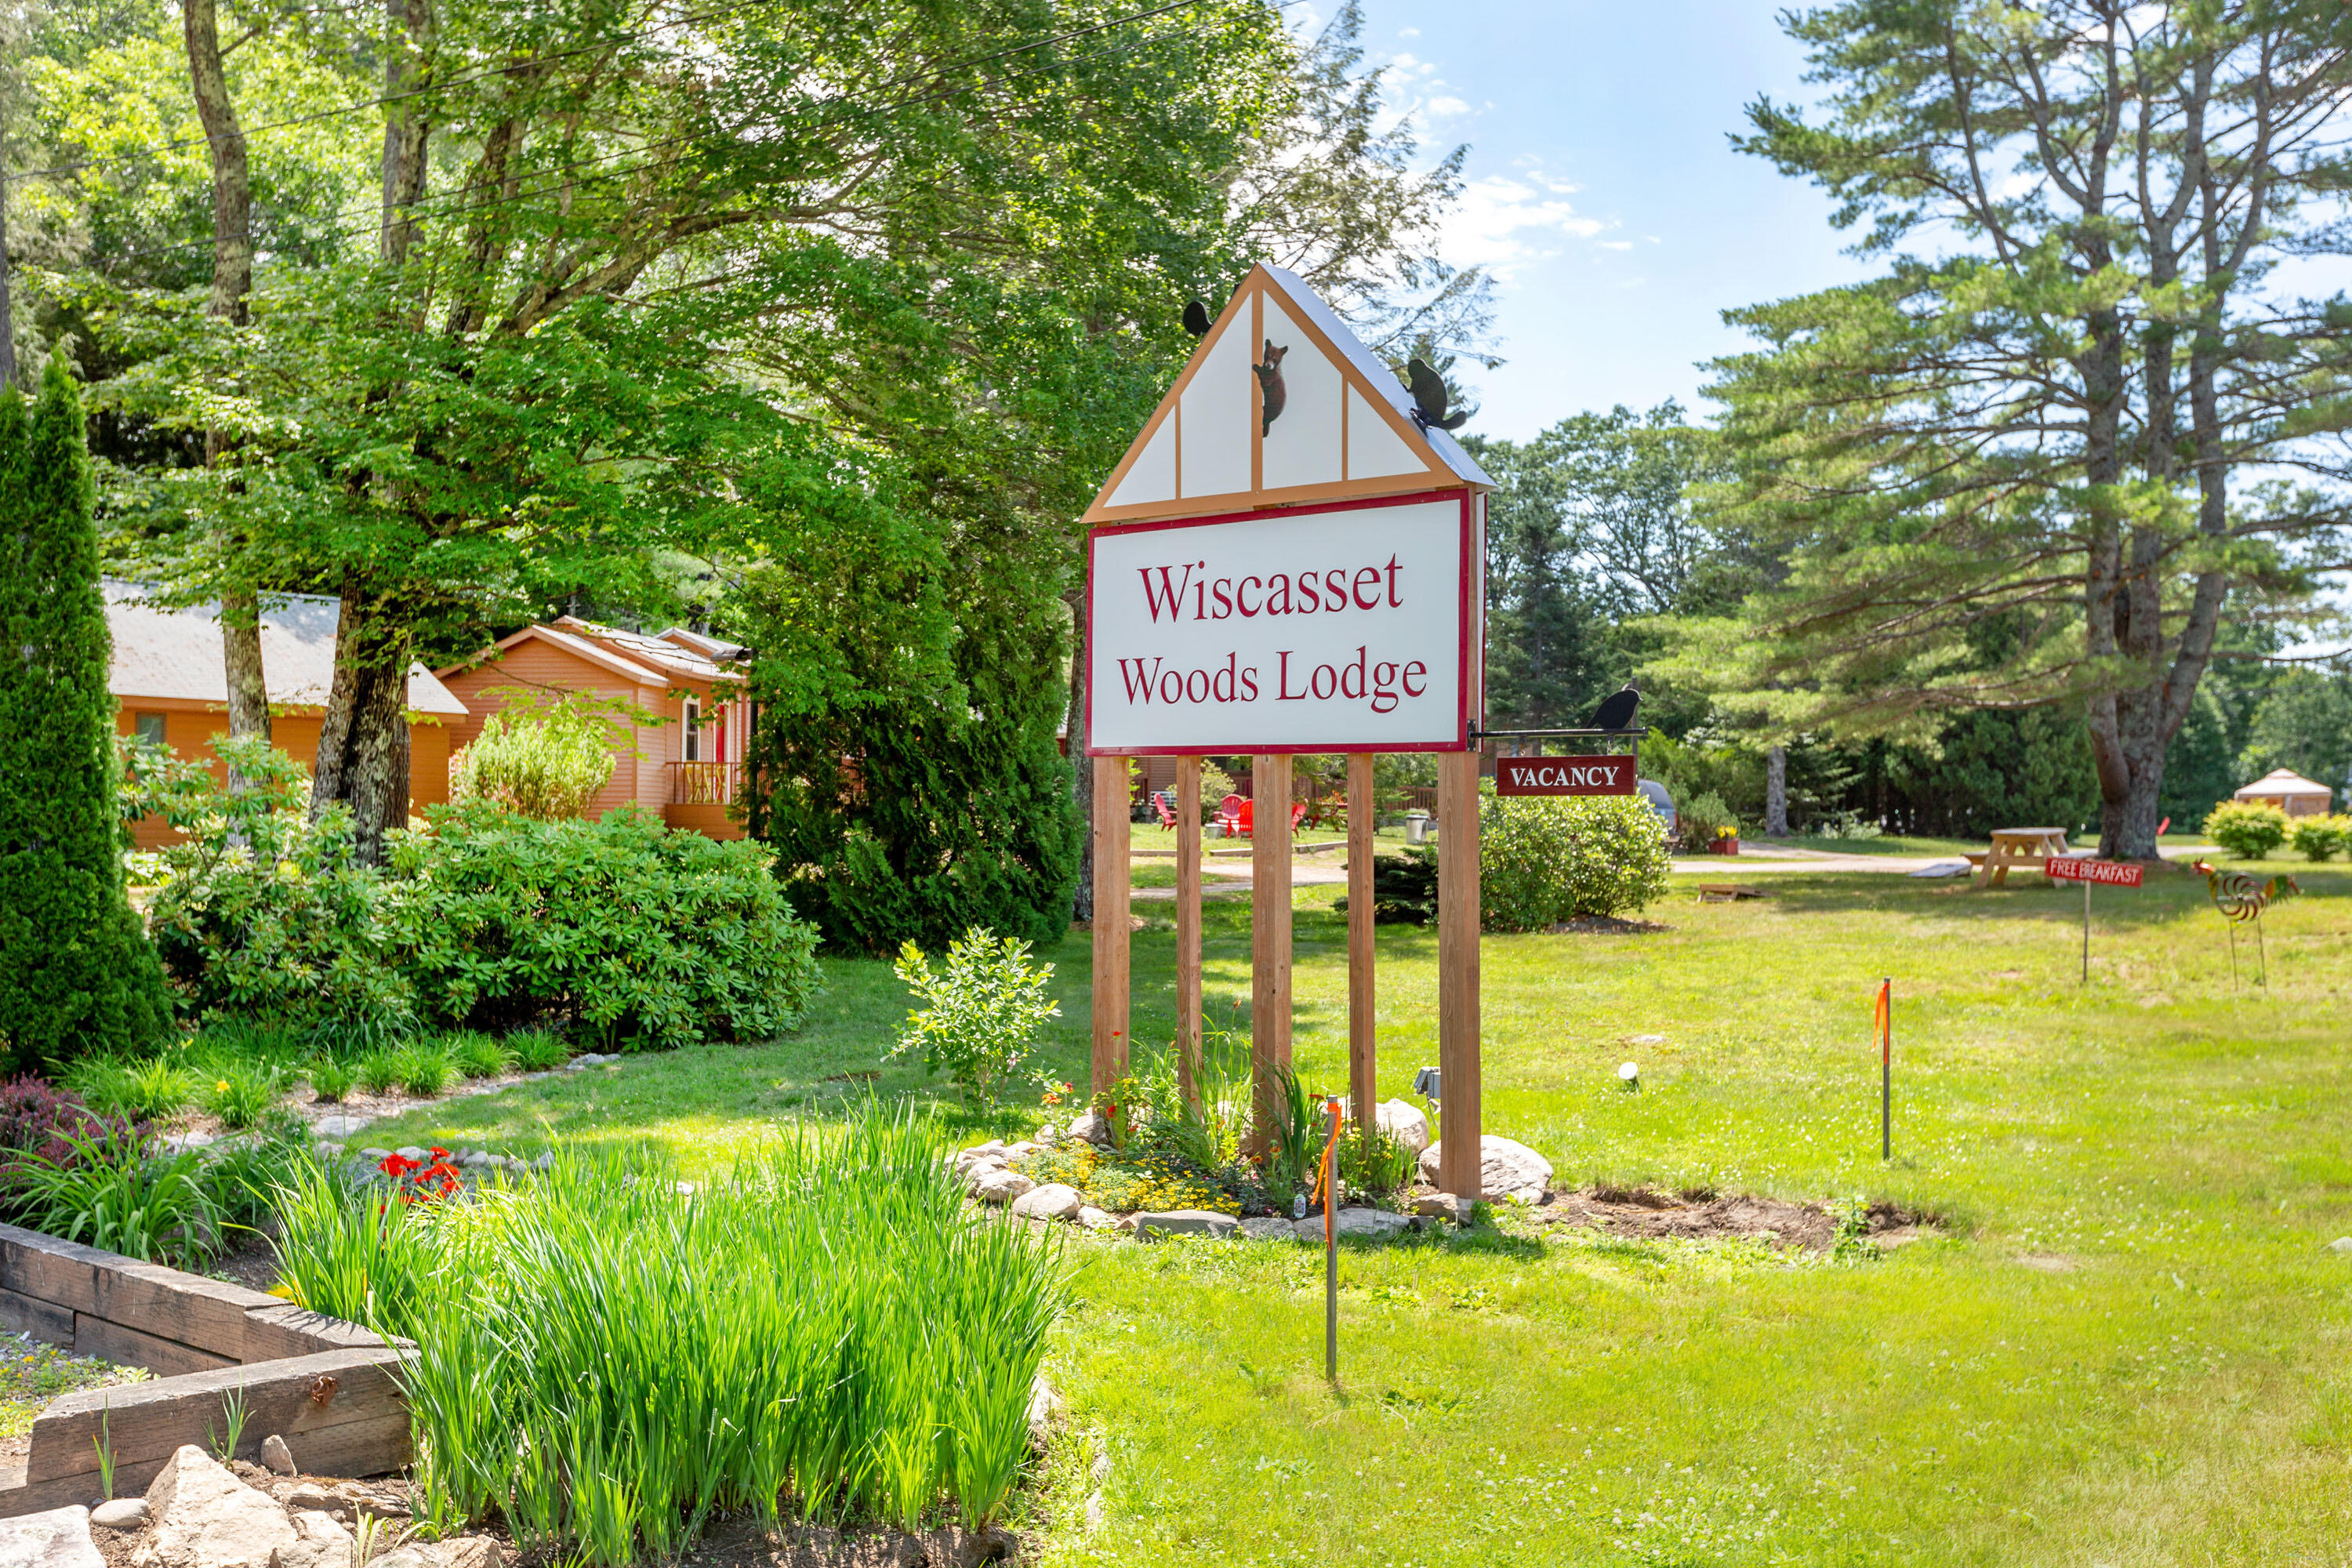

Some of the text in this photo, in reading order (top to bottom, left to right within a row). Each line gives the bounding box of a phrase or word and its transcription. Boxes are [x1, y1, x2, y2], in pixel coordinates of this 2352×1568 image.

[1137, 552, 1403, 624] Wiscasset
[1116, 645, 1428, 713] Woods Lodge
[1510, 766, 1619, 786] VACANCY
[2050, 859, 2140, 883] FREE BREAKFAST
